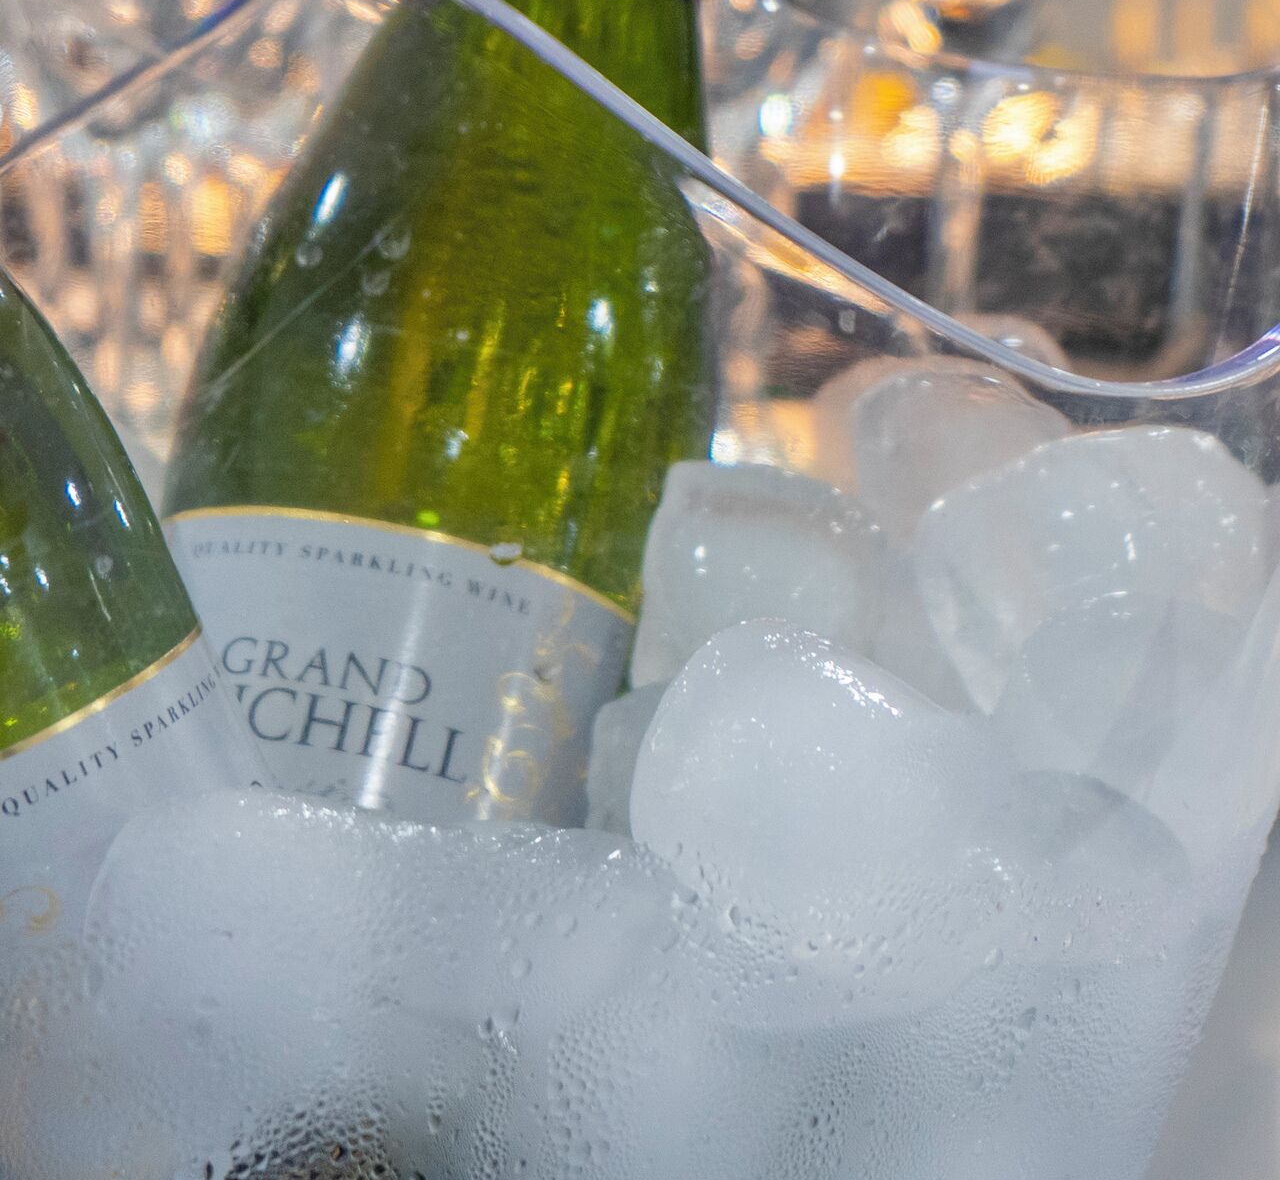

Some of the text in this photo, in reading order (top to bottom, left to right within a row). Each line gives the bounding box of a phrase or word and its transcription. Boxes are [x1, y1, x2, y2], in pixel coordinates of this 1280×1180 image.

[191, 540, 533, 615] QUALITY SPARKLING WINE
[222, 636, 433, 707] GRAND
[1, 672, 218, 817] QUALITY SPARKLING
[235, 683, 469, 785] CHELL
